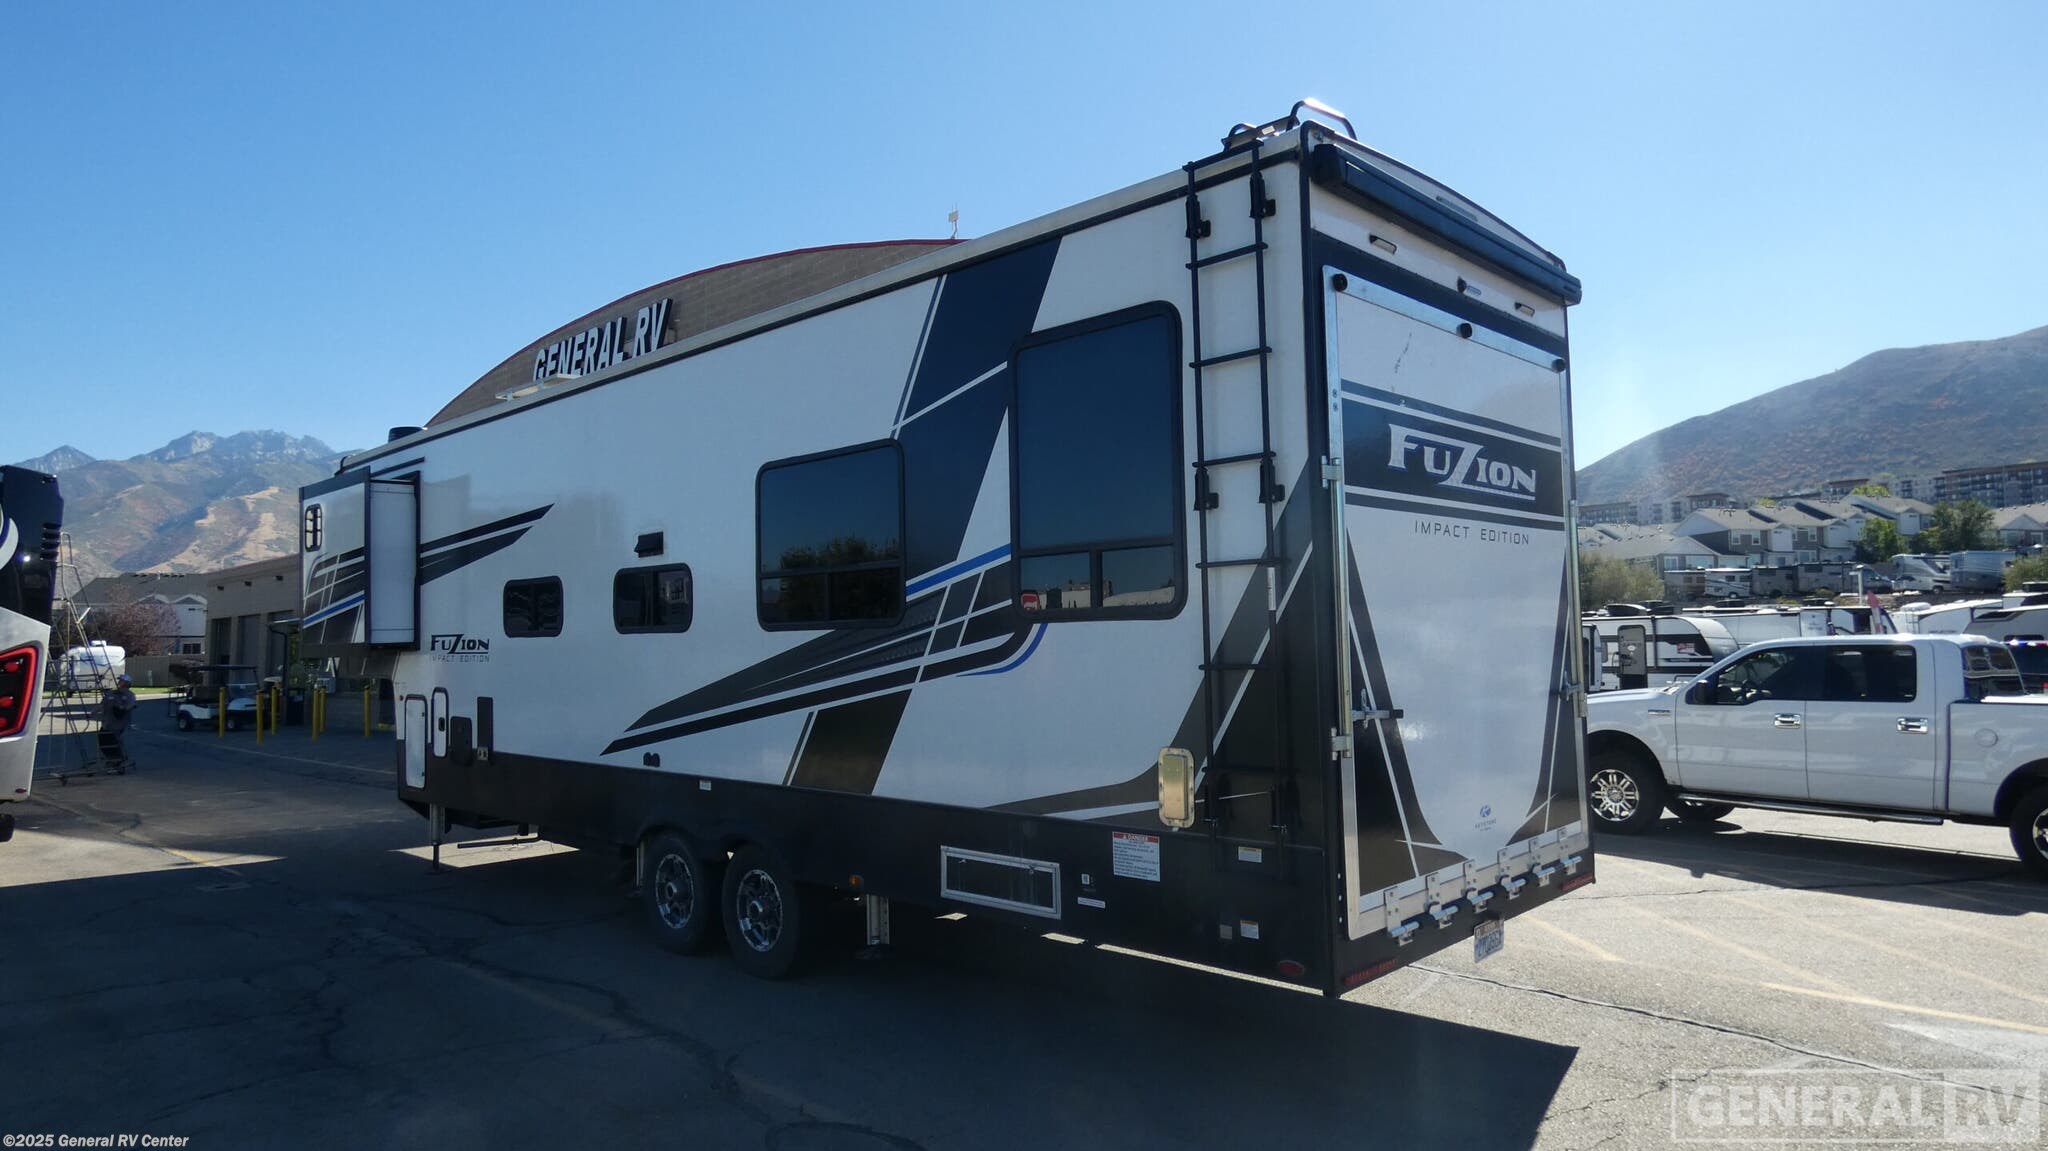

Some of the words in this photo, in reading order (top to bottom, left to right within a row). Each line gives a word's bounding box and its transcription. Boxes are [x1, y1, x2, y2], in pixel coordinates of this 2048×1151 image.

[533, 317, 624, 382] GENERAL
[632, 298, 669, 358] RV
[1388, 424, 1536, 500] FUZION
[1414, 520, 1471, 539] IMPACT
[1480, 528, 1530, 545] EDITION
[430, 634, 490, 654] FUZION
[459, 654, 490, 663] EDITION
